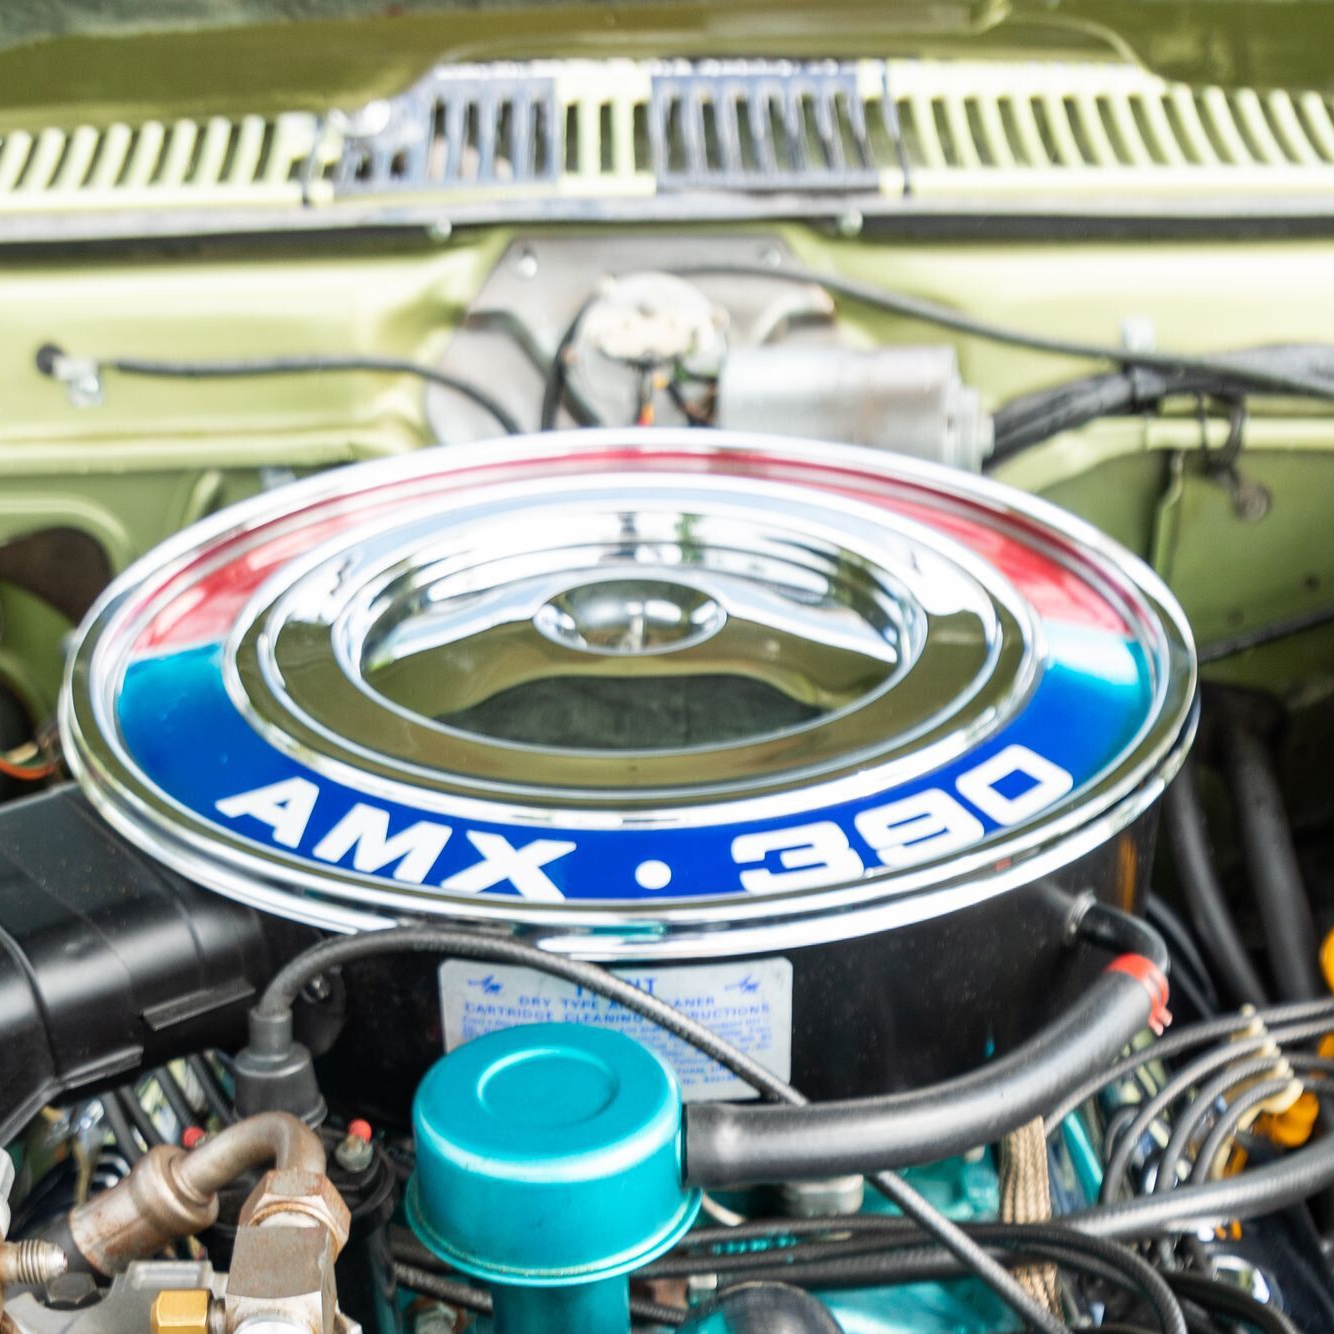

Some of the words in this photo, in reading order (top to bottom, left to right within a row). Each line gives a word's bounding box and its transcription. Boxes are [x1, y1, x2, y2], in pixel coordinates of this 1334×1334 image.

[220, 776, 577, 902] AMX
[731, 743, 1073, 896] 390
[519, 995, 551, 1008] DRY
[562, 998, 598, 1010] TYPE
[465, 1003, 553, 1021] CARTRIDGE
[565, 1012, 644, 1024] CLEANING
